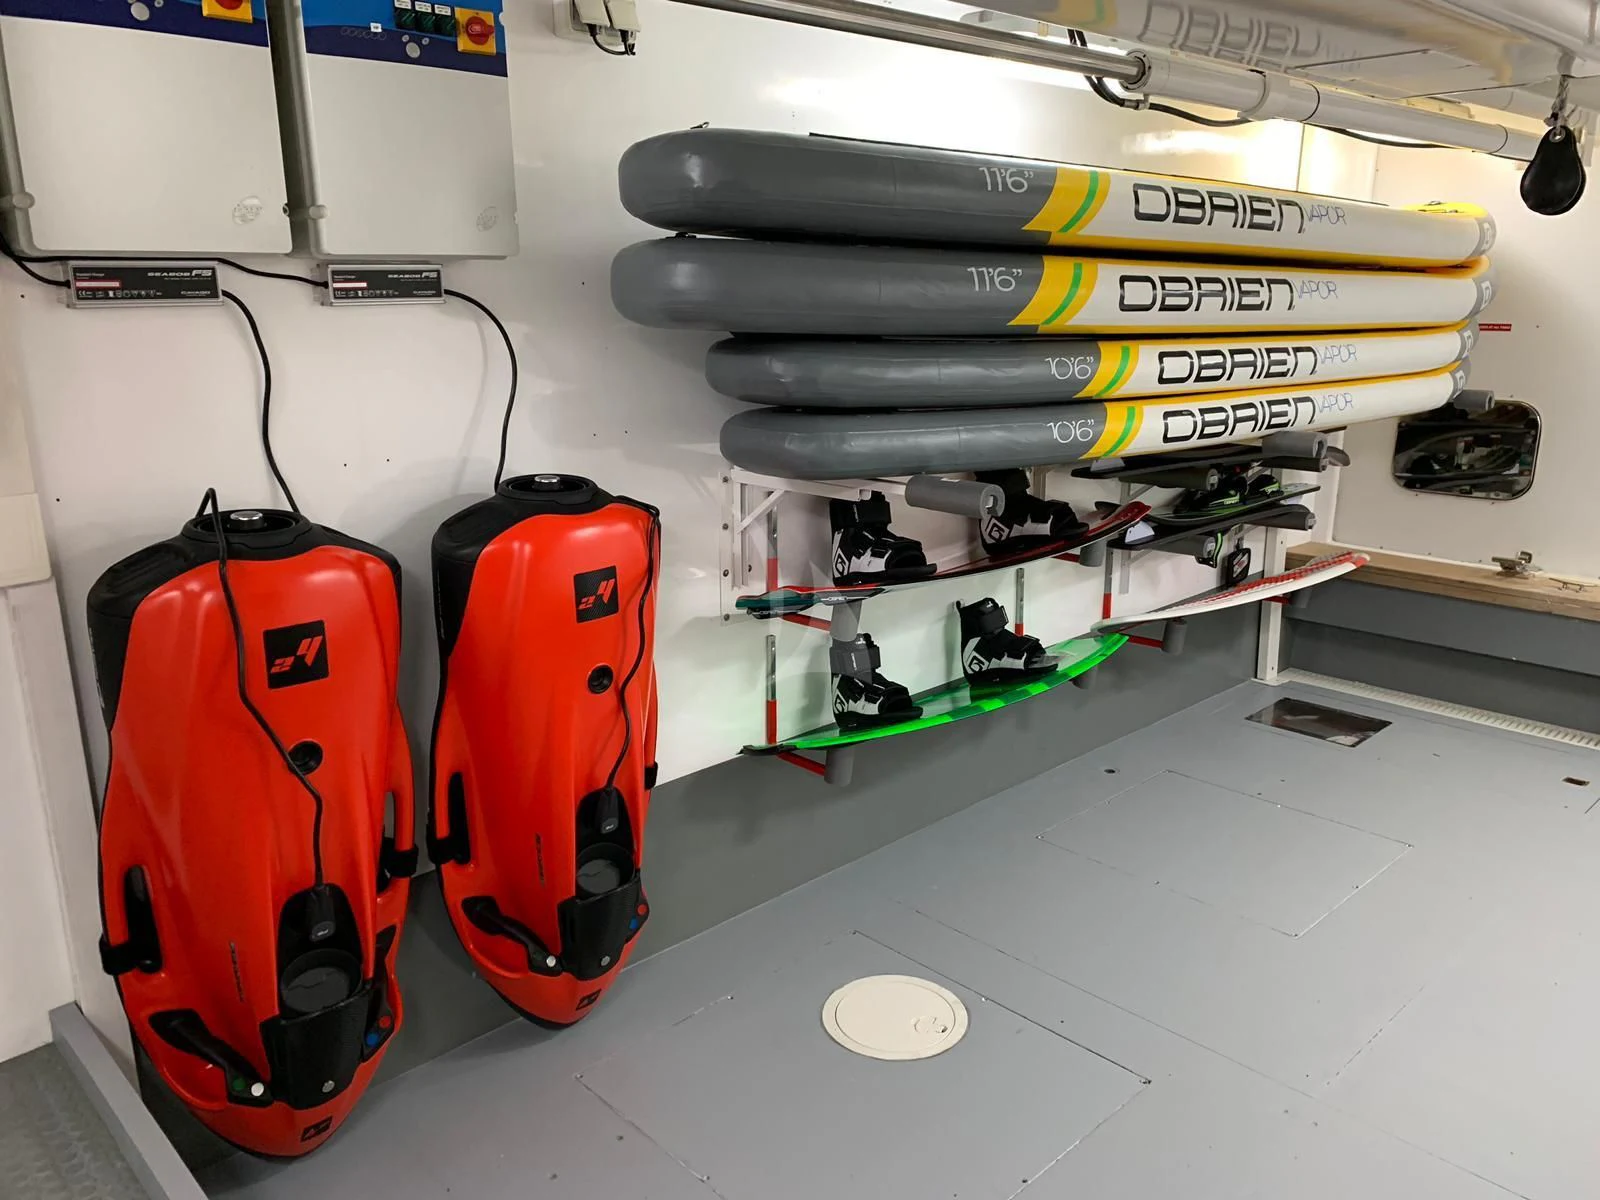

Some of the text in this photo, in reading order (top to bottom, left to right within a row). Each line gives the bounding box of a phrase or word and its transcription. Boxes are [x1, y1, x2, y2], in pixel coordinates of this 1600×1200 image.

[1132, 183, 1347, 234] OBRIEN VAPOR
[1118, 275, 1338, 312] OBRIEN VAPOR
[1158, 343, 1358, 385] OBRIEN VAPOR
[1162, 392, 1354, 444] OBRIEN VAPOR
